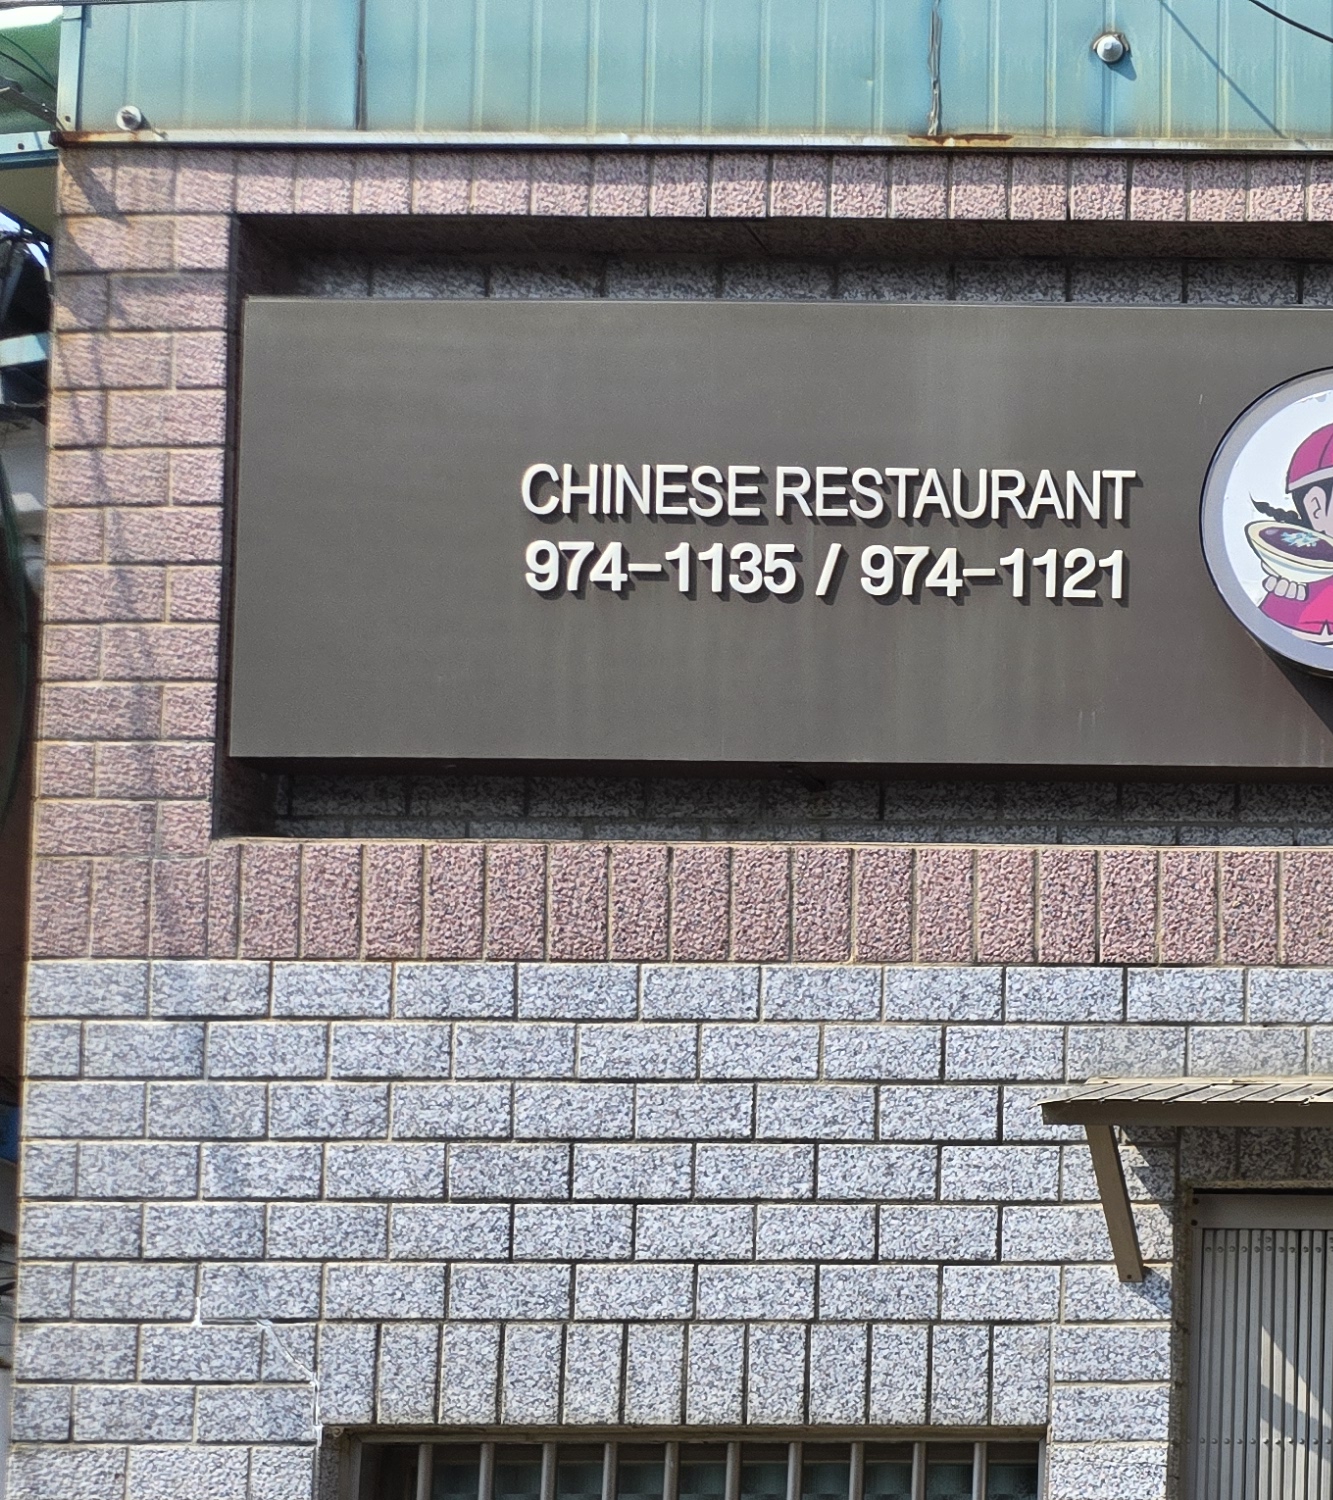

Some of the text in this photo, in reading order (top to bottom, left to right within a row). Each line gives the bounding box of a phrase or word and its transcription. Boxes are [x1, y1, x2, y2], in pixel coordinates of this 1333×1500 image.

[521, 463, 1138, 523] CHINESE RESTAURANT
[523, 540, 797, 596] 974-1135
[859, 546, 1126, 601] 974-1121
